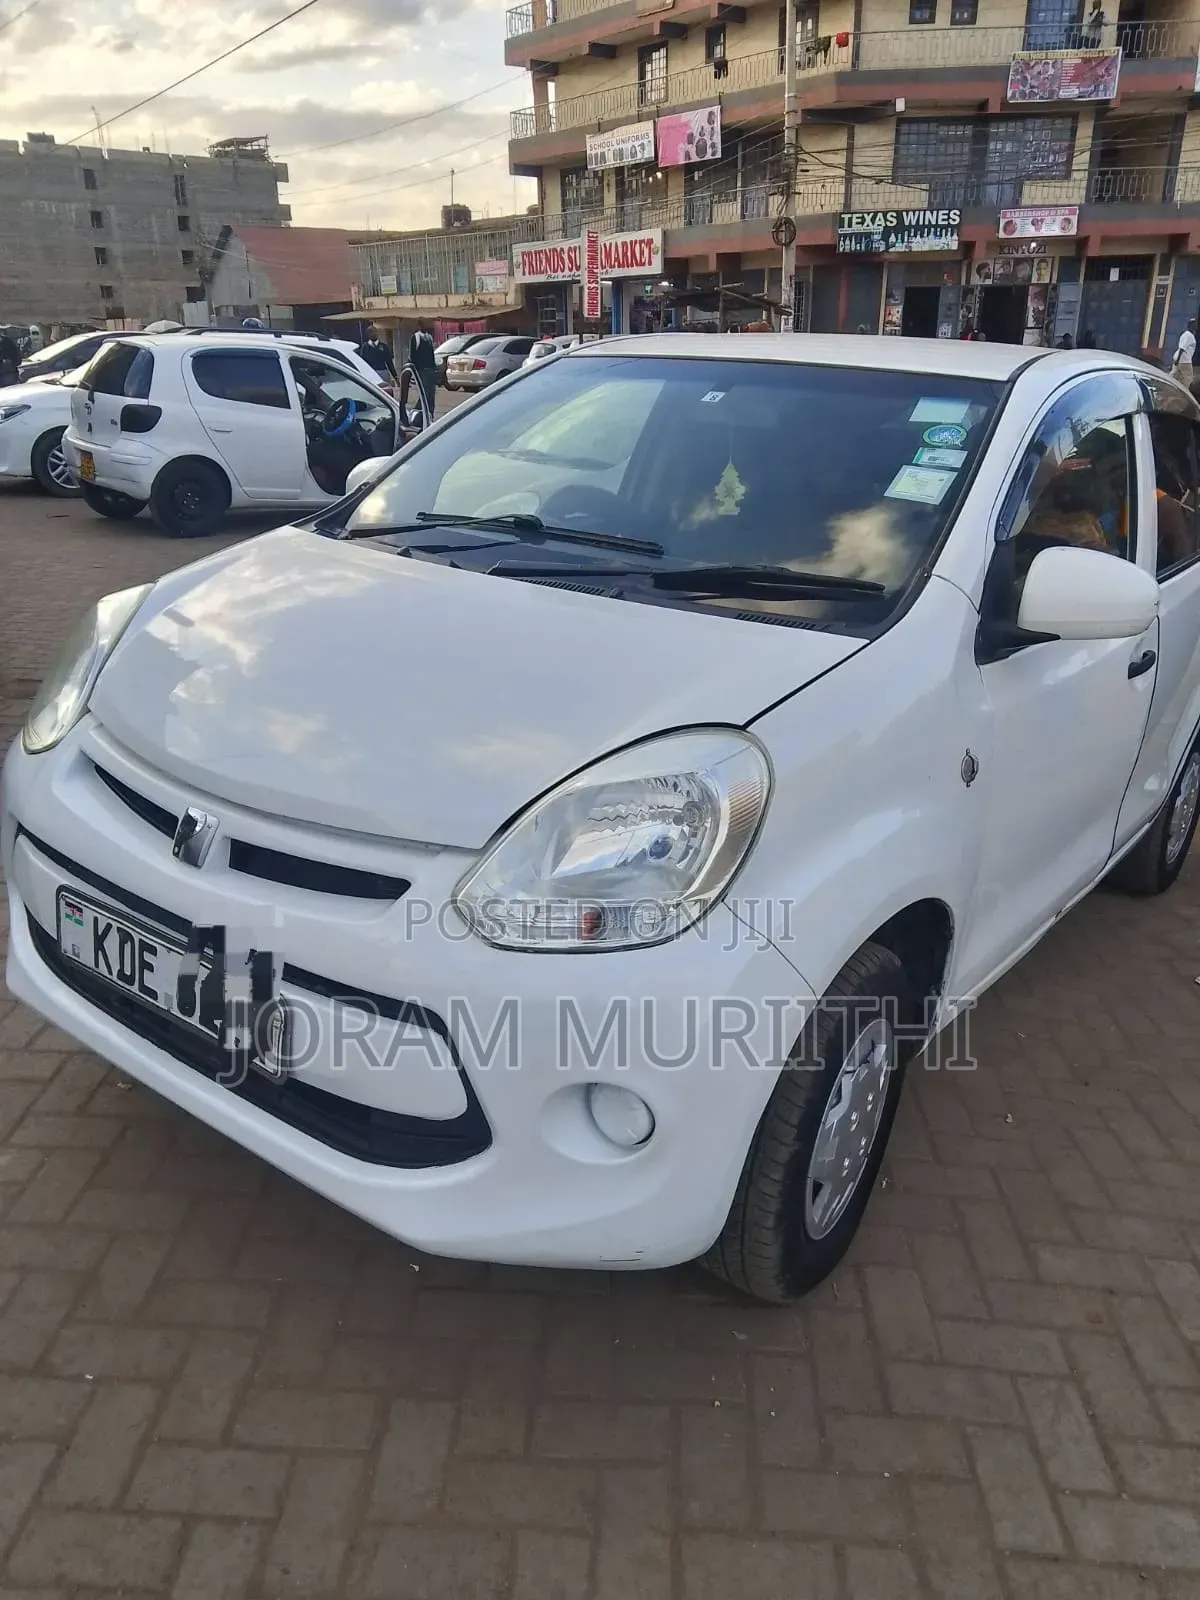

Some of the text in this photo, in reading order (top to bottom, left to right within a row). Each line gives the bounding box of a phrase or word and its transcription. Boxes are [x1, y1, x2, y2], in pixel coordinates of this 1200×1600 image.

[589, 132, 650, 151] SCHOOL UNIFORMS
[841, 209, 961, 229] TEXAS WINES
[1006, 209, 1049, 218] BARBERSHOP
[521, 246, 566, 276] FRIENDS
[567, 237, 654, 273] SUMARKET
[587, 230, 599, 317] FRIENDS SUPERMARKET
[93, 915, 159, 1002] KDE
